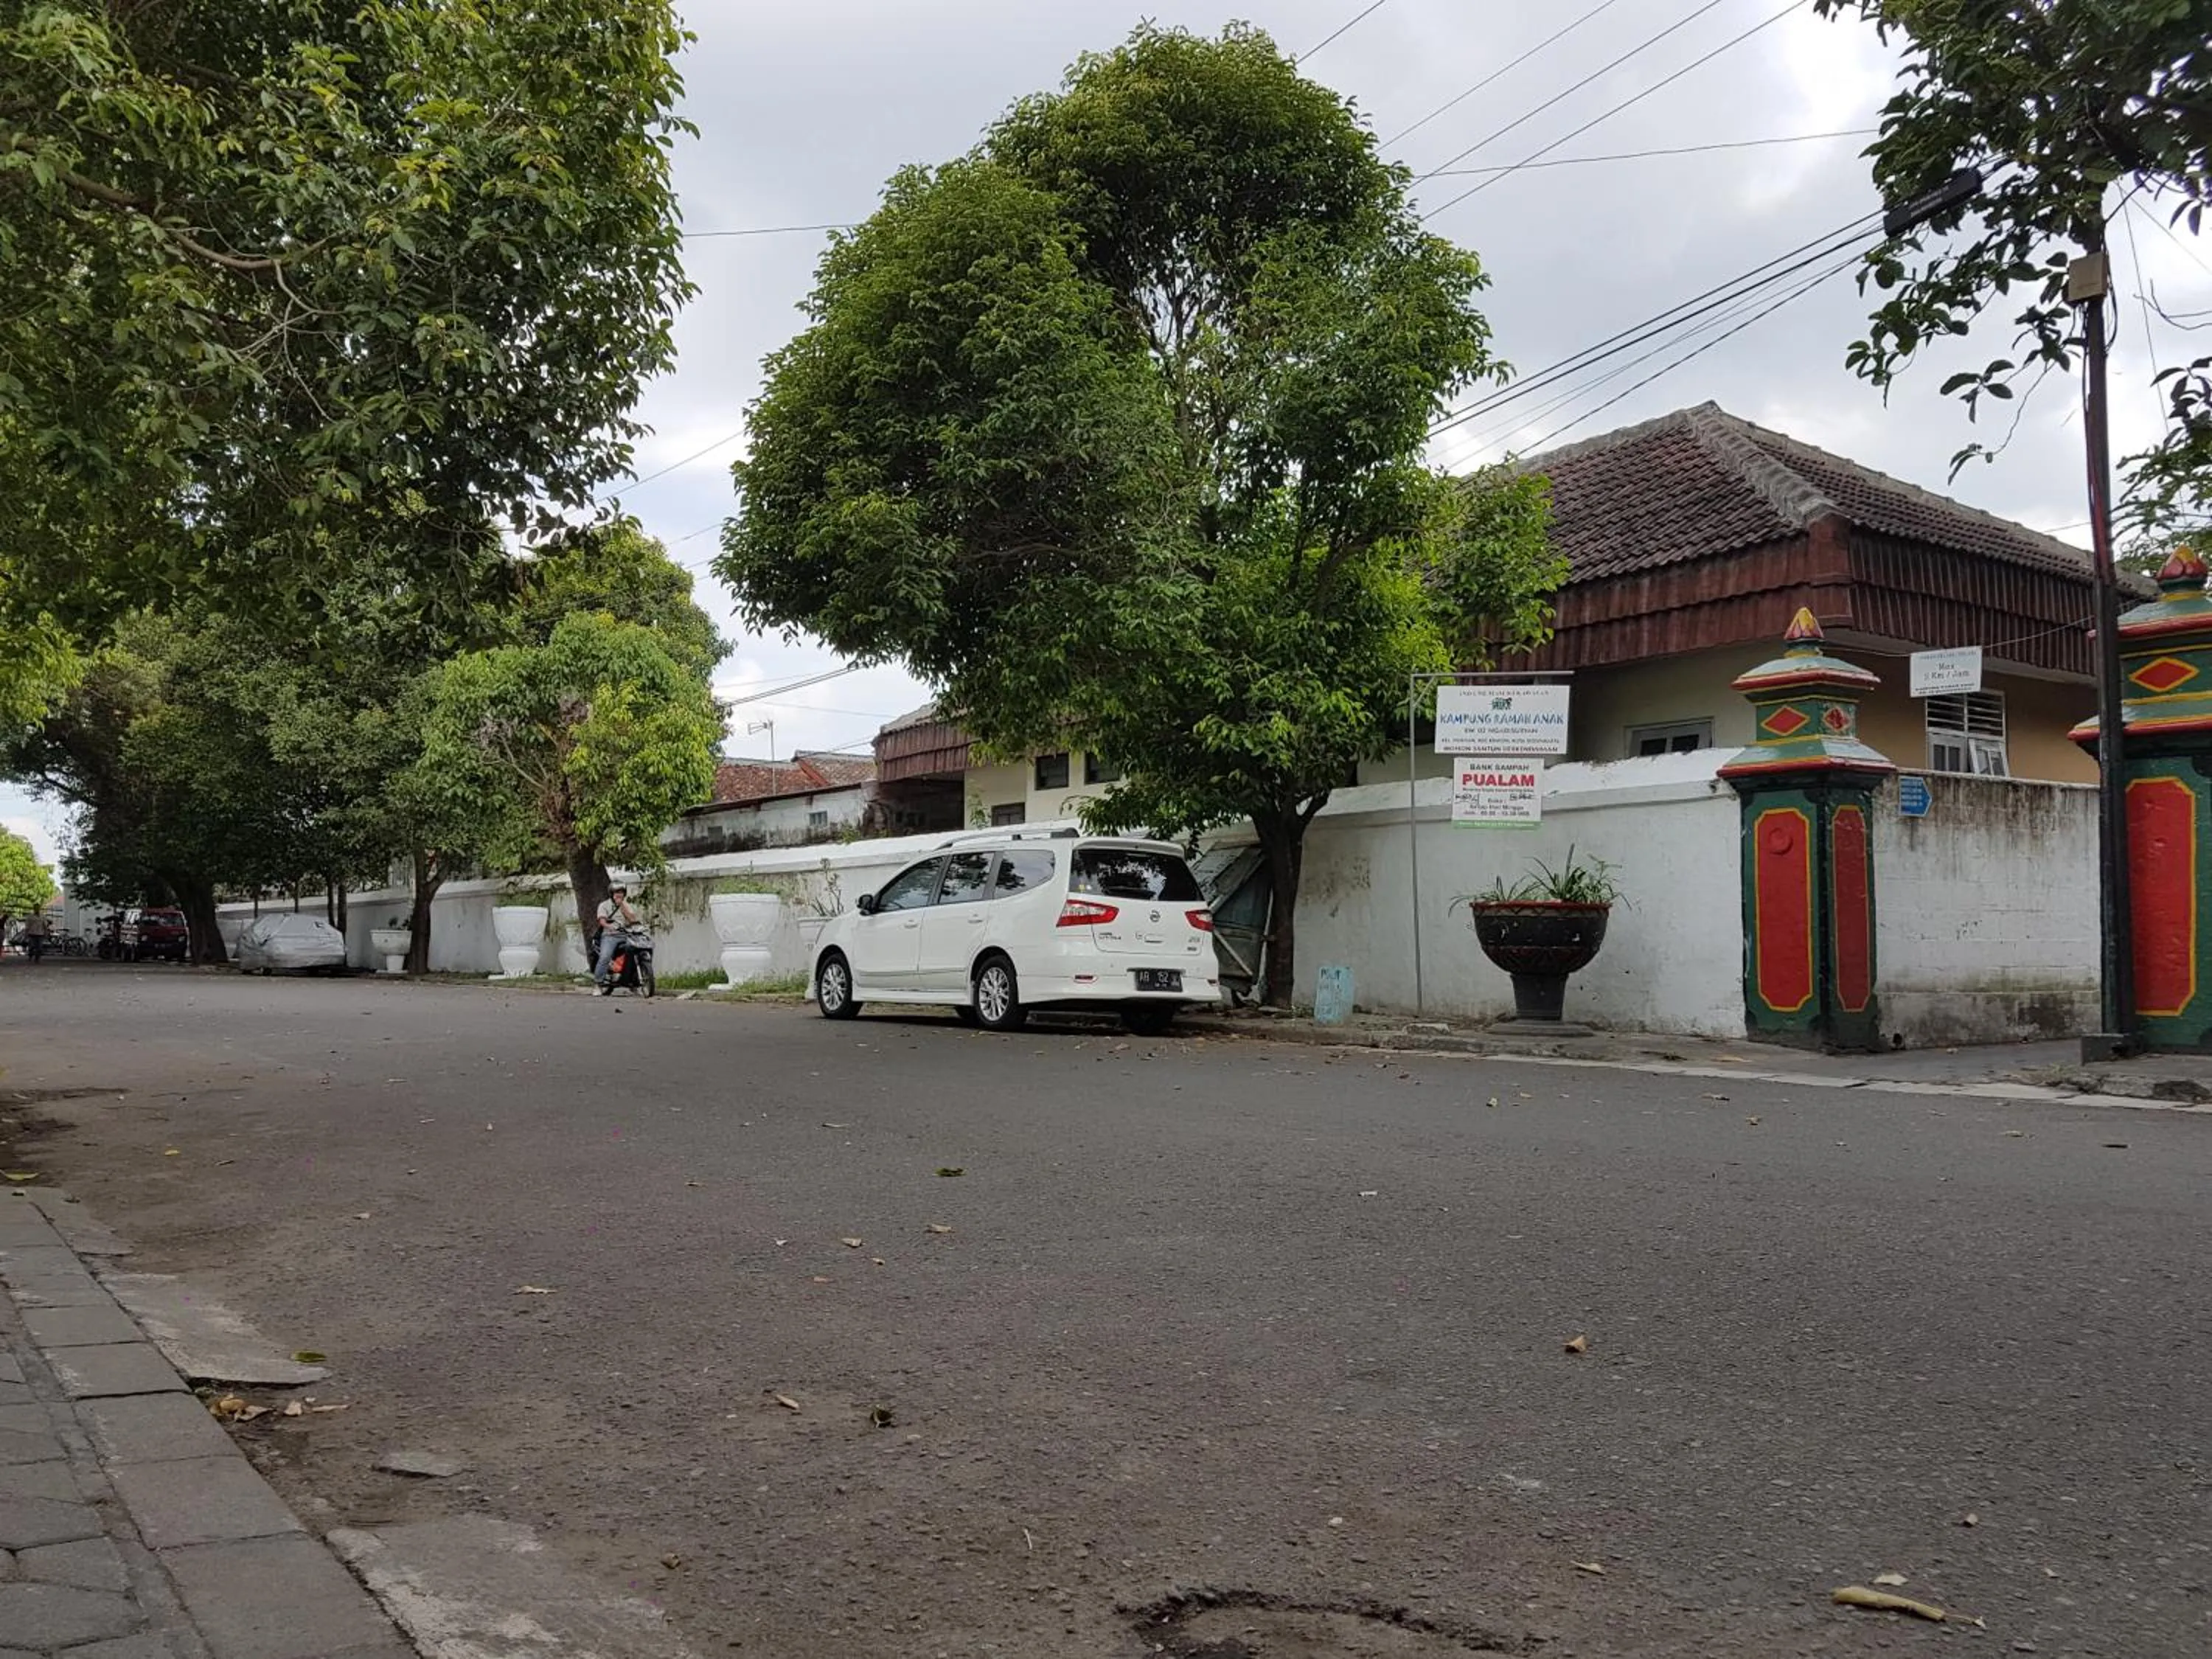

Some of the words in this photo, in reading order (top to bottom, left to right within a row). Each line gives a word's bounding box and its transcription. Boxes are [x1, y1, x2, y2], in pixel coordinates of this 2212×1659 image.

[1440, 713, 1492, 724] KAMPUNG
[1532, 713, 1564, 724] ANAK
[1462, 773, 1534, 786] PUALAM
